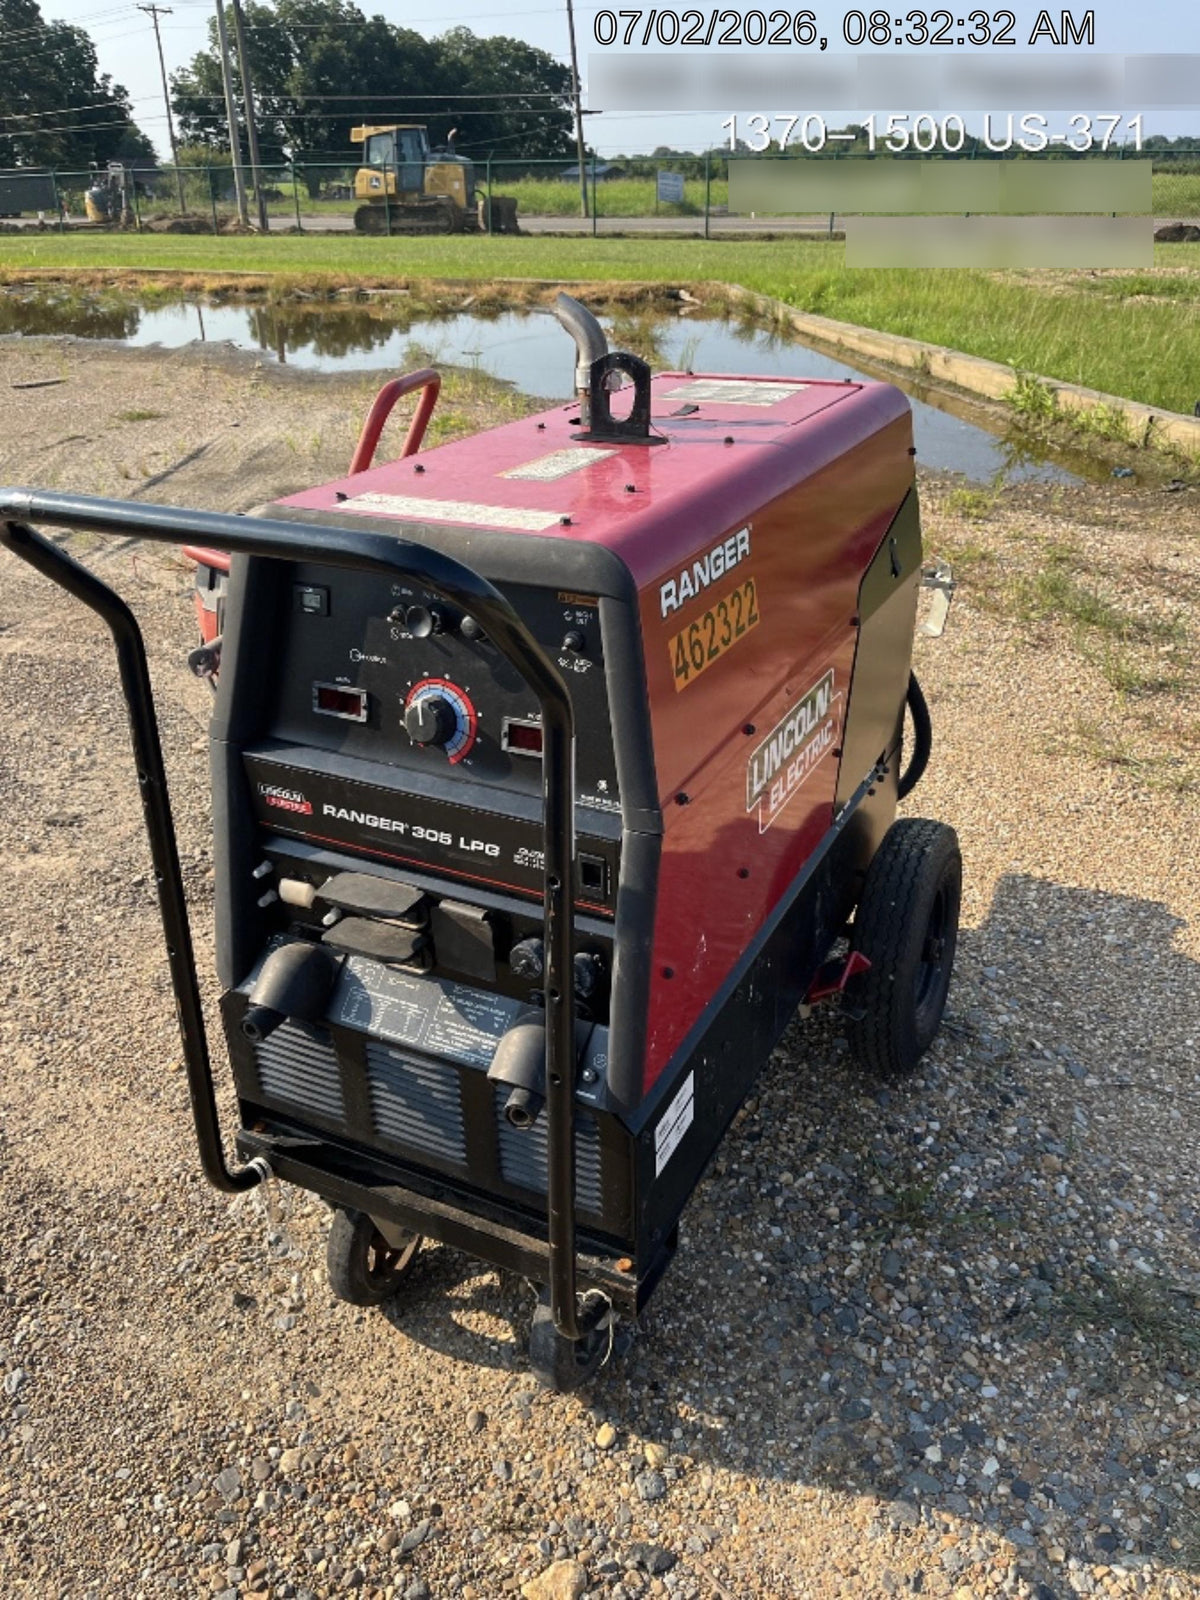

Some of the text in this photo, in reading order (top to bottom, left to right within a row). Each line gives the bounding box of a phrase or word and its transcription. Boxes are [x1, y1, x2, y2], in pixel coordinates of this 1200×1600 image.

[660, 526, 751, 619] RANGER
[674, 580, 758, 681] 462322
[751, 680, 831, 794] LINCOLN
[769, 719, 833, 814] ELECTRIC
[322, 804, 500, 857] RANGER 305 LPG
